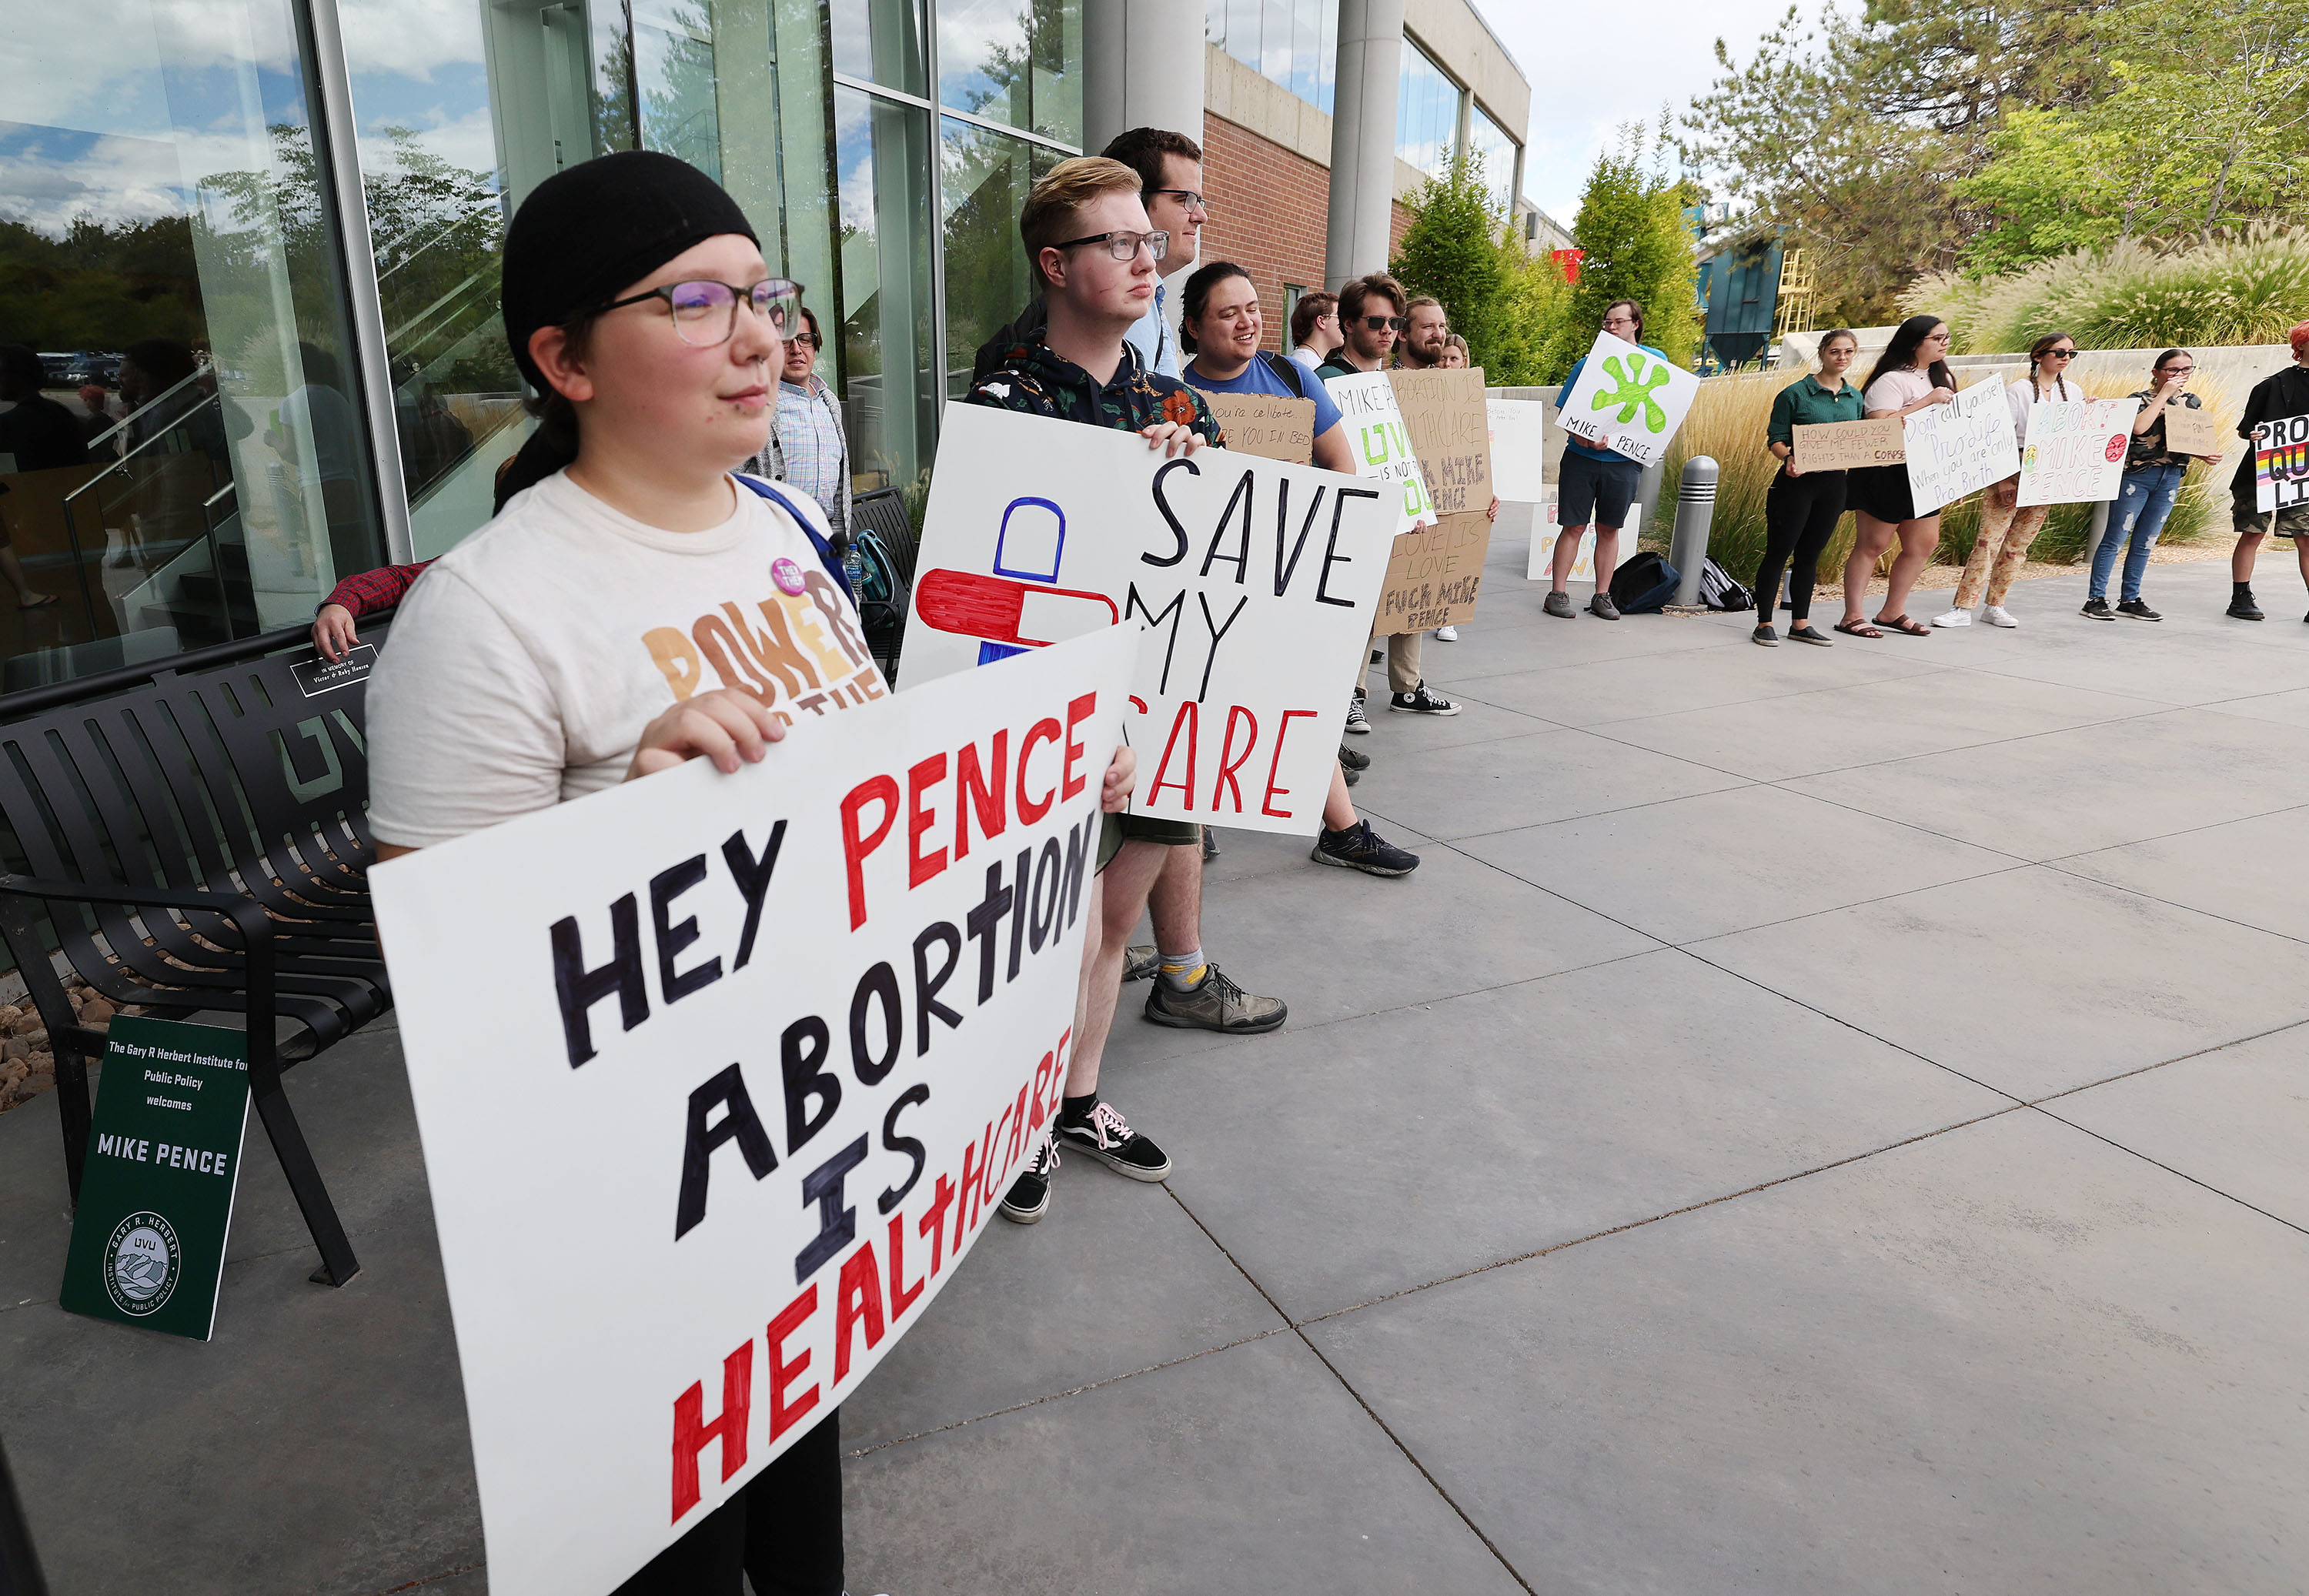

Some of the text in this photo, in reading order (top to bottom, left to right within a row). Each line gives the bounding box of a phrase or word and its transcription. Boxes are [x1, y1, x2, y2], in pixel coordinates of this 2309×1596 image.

[1338, 386, 1384, 416] MIKE
[1396, 374, 1485, 406] BORTION IS
[1941, 395, 1961, 422] call
[1965, 376, 2003, 418] yourself
[1401, 409, 1482, 450] ALTHCARE
[1802, 425, 1891, 440] HOW COULD YOU
[2035, 401, 2118, 434] ABORT
[2257, 416, 2308, 450] PRO
[1241, 426, 1264, 447] YOU
[1270, 429, 1285, 442] IN
[1289, 431, 1311, 446] BED
[1566, 416, 1651, 460] MIKE PENCE
[1799, 437, 1888, 449] GIVE ME FEWER
[2035, 433, 2107, 471] MIKE
[1395, 462, 1412, 477] NOT
[1441, 453, 1484, 487] MIKE
[1801, 450, 1906, 464] RIGHTS THAN A CORPSE
[1911, 431, 2013, 490] When you are only
[2025, 468, 2103, 500] PENCE
[1141, 458, 1379, 608] SAVE
[1392, 519, 1485, 559] LOVE IS
[1406, 556, 1459, 579] LOVE
[1385, 575, 1479, 616] FUCK MIKE
[1408, 607, 1450, 629] PENCE
[641, 570, 870, 710] POWER
[1124, 581, 1248, 703] MY
[328, 663, 347, 672] MEMORY
[1128, 694, 1318, 819] ARE
[550, 691, 1096, 1070] HEY PENCE
[675, 809, 1096, 1243] ABORTION
[109, 1041, 125, 1053] The
[127, 1043, 147, 1059] Gary
[149, 1047, 155, 1058] R
[157, 1047, 192, 1063] Herbert
[193, 1053, 233, 1069] Institute
[144, 1070, 203, 1091] Public Policy
[146, 1095, 192, 1111] welcomes
[97, 1133, 227, 1176] MIKE PENCE
[795, 1083, 930, 1286] IS
[112, 1221, 131, 1248] GARY
[148, 1217, 178, 1259] HERBERT
[135, 1237, 156, 1251] UVU
[108, 1263, 123, 1303] INSTITUTE
[132, 1300, 155, 1311] PUBLIC
[155, 1277, 173, 1303] POLICY
[671, 1027, 1072, 1527] HEALTHCARE
